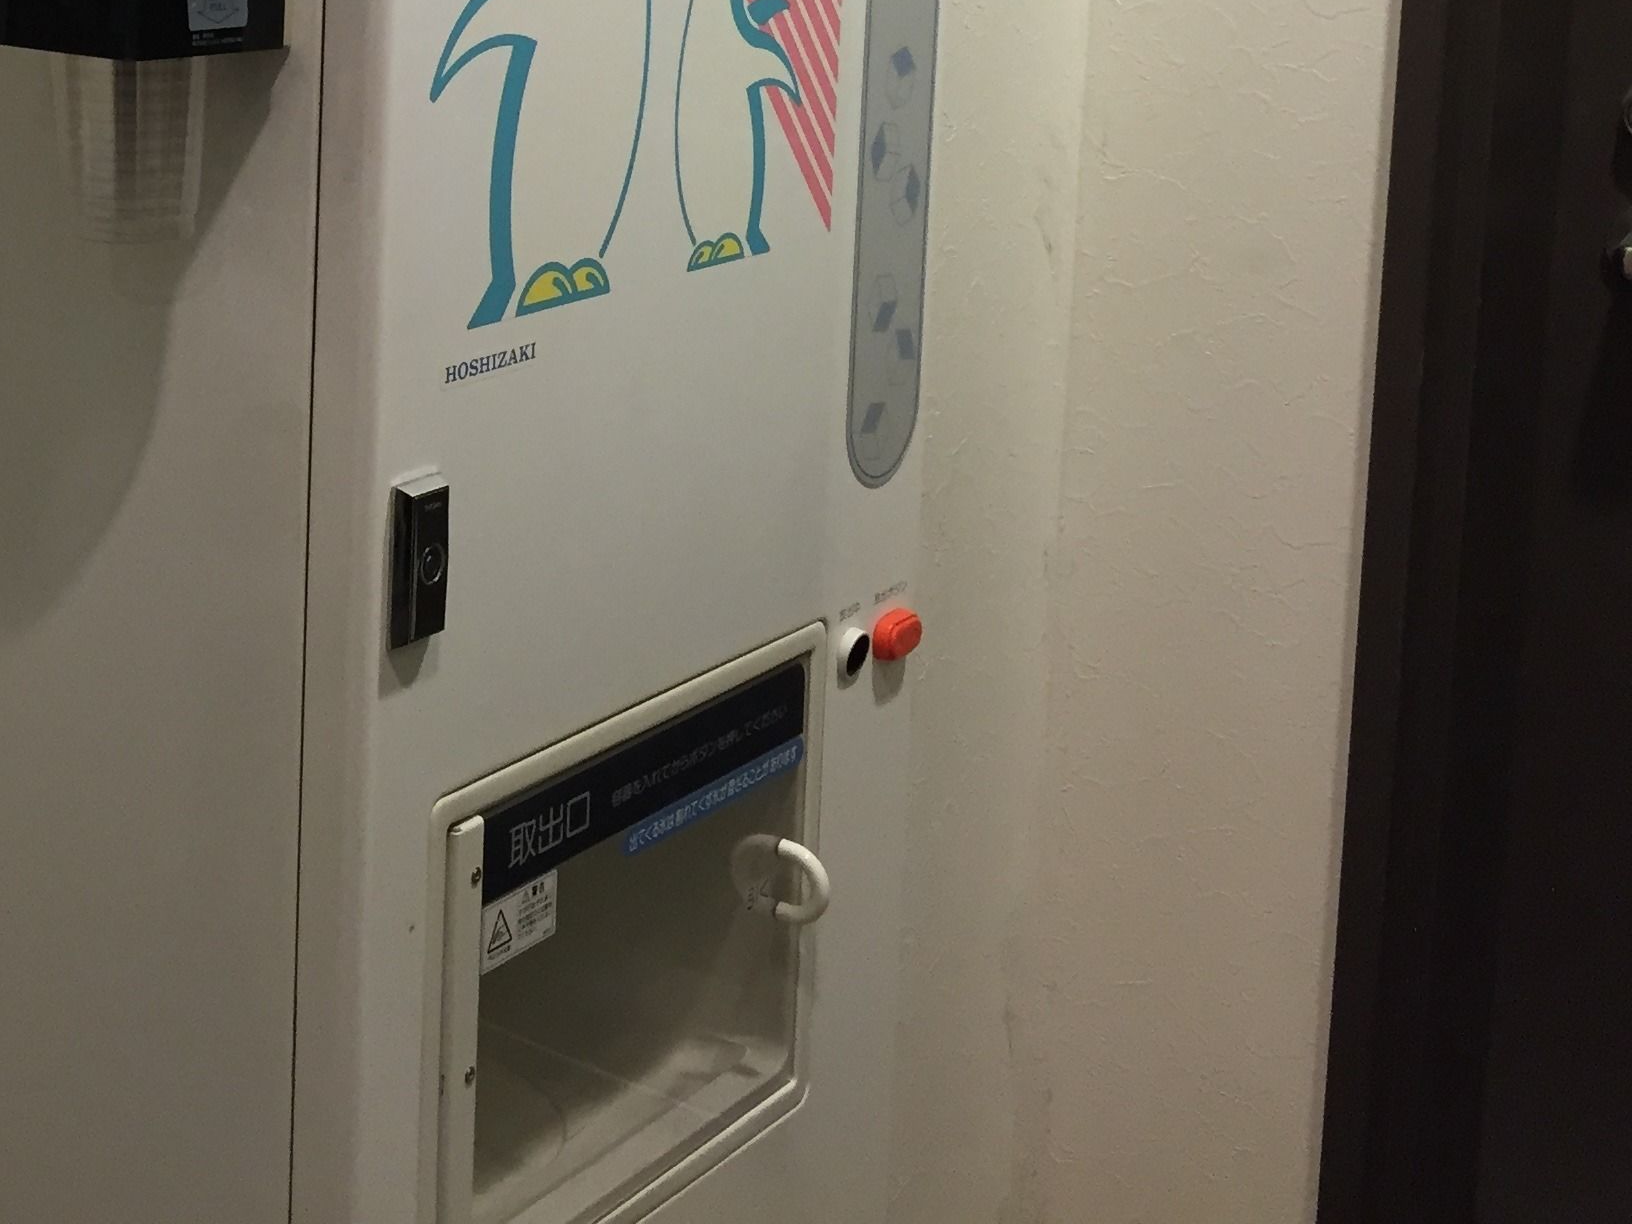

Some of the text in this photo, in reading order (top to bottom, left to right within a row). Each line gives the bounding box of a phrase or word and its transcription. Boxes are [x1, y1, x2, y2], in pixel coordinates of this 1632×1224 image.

[444, 341, 537, 384] HOSHIZAKI
[507, 790, 591, 869] 取出口
